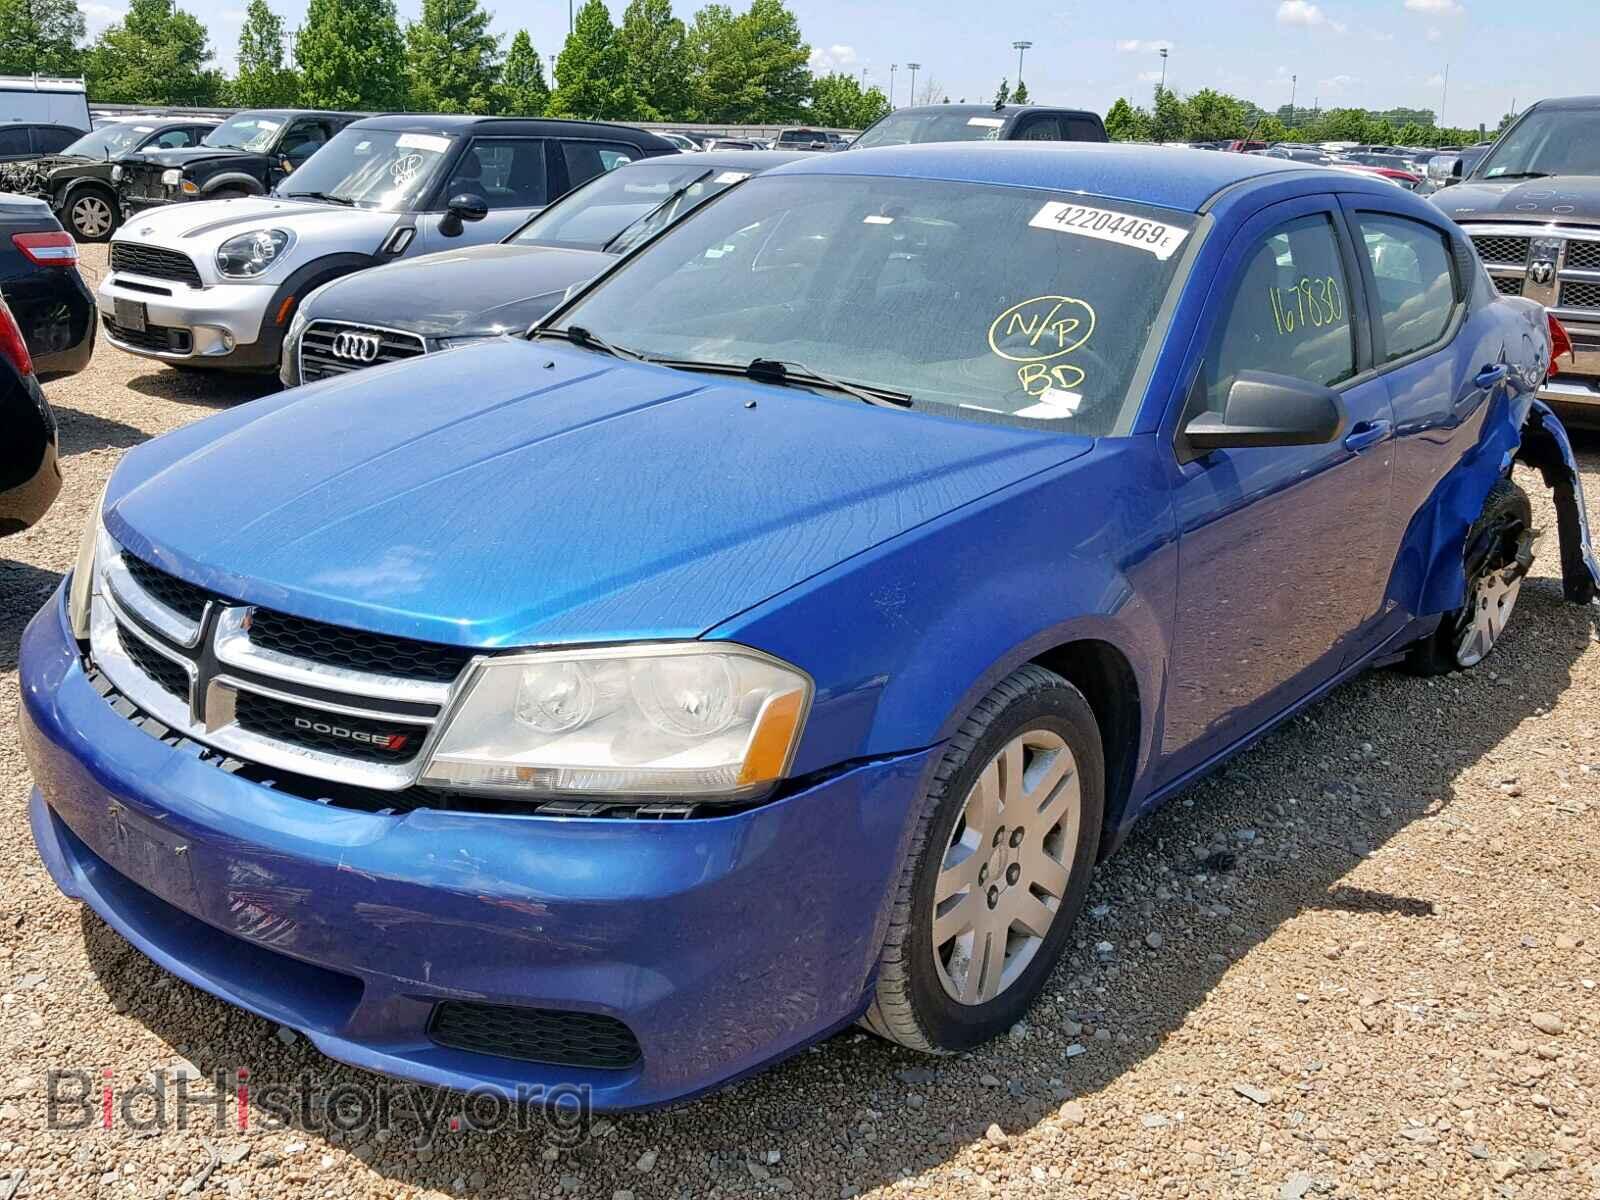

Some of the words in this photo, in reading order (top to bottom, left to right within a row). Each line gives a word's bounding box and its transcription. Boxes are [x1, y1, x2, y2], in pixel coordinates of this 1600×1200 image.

[1054, 206, 1166, 244] 42204469
[1269, 276, 1342, 335] 167830
[1003, 301, 1082, 349] N/P
[1018, 363, 1085, 395] BD
[294, 717, 391, 746] DODGE
